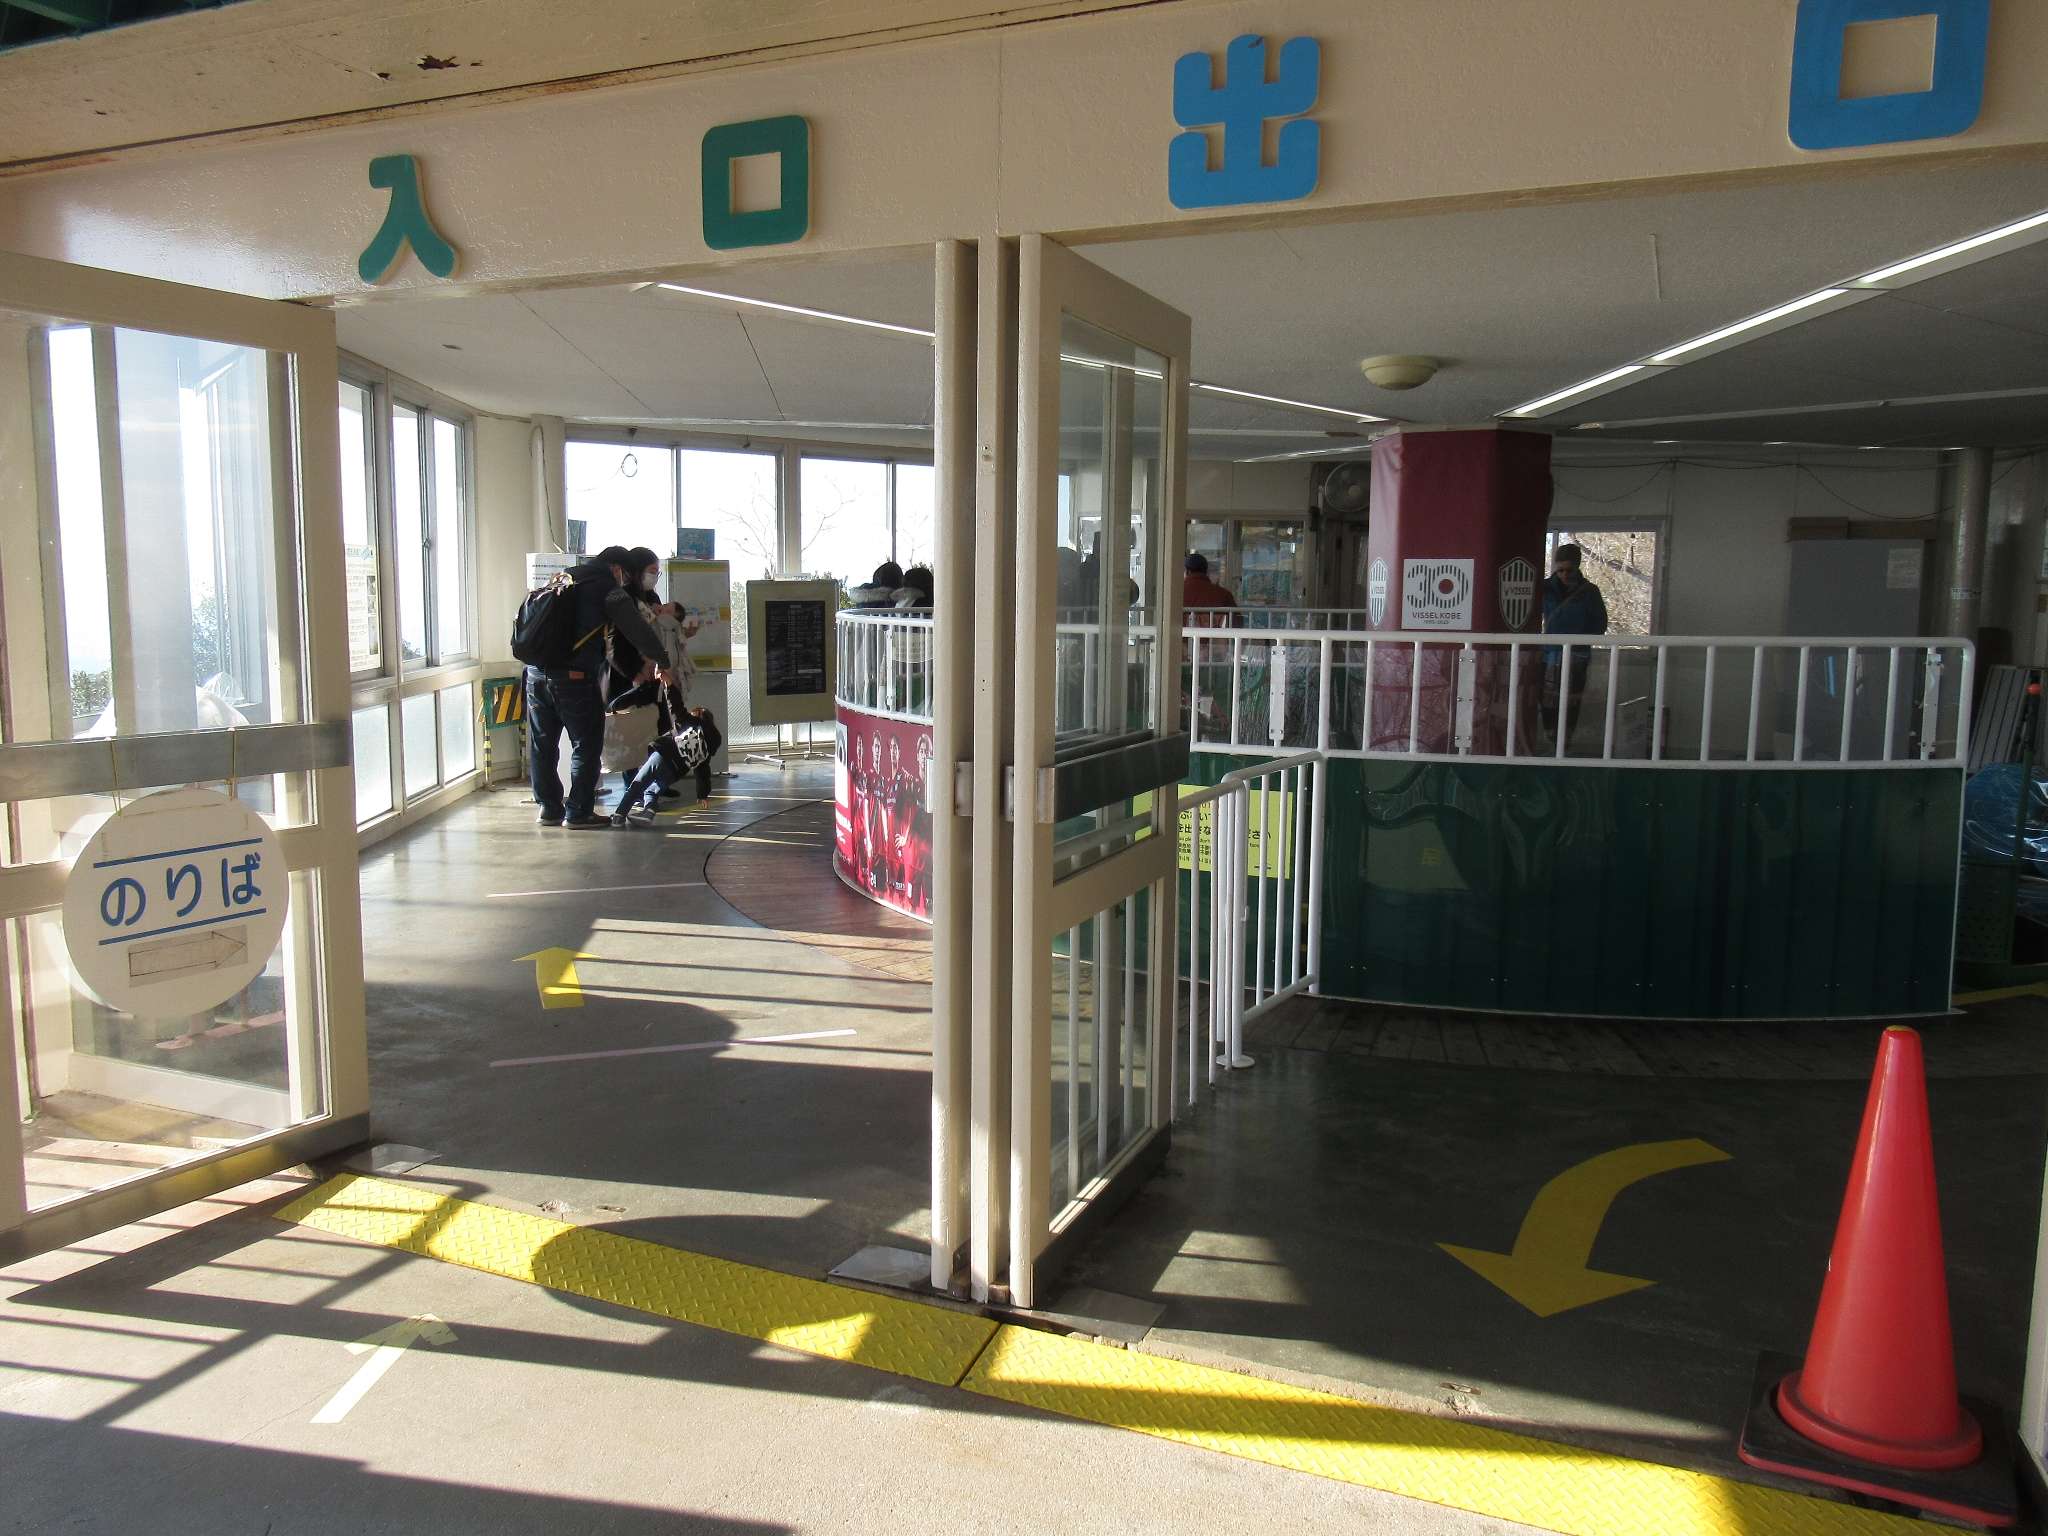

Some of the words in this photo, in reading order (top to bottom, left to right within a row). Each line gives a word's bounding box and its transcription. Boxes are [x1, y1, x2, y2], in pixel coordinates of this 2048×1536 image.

[1168, 0, 1990, 209] 出口
[358, 115, 809, 283] 入口
[1406, 565, 1469, 609] 30
[1412, 611, 1438, 620] VISSEL
[1439, 612, 1462, 620] KOBE
[100, 851, 262, 927] のりば
